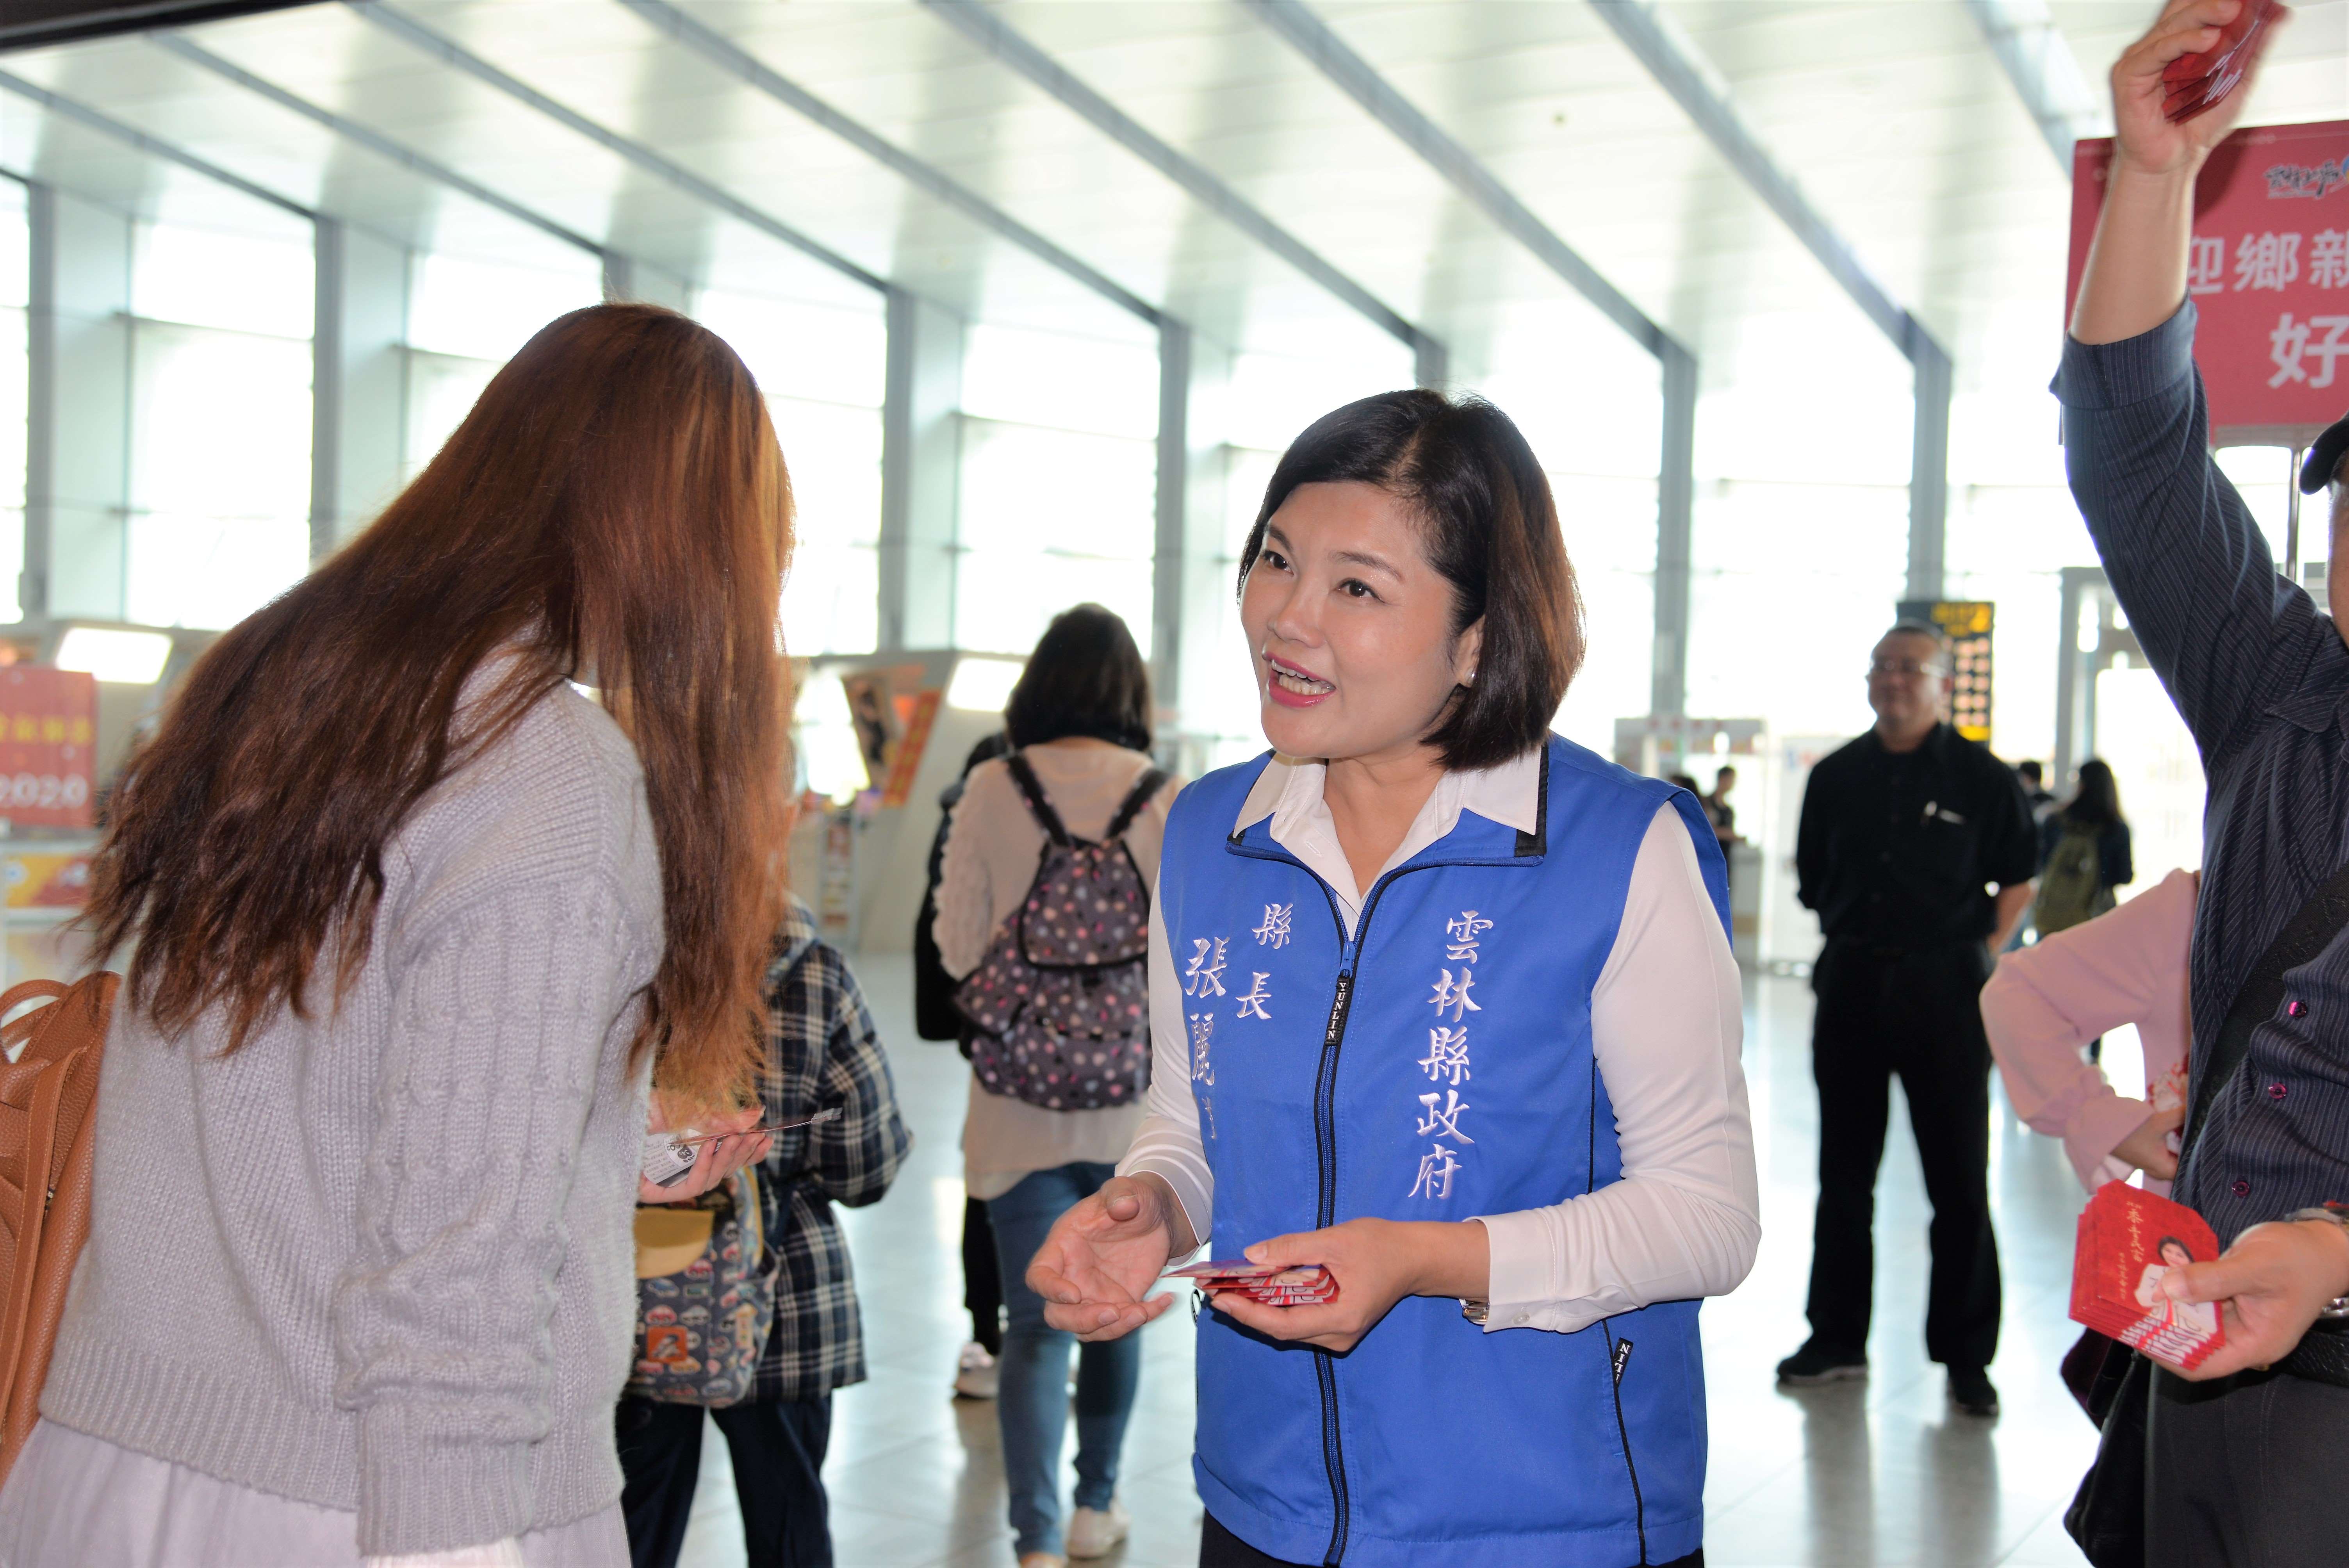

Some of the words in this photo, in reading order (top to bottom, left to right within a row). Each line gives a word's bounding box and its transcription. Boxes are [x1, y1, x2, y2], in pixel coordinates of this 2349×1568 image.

[2267, 312, 2349, 389] 好
[1235, 903, 1293, 1020] 縣長
[1328, 982, 1347, 1039] YUNLIN
[1408, 910, 1494, 1200] 雲林縣政府
